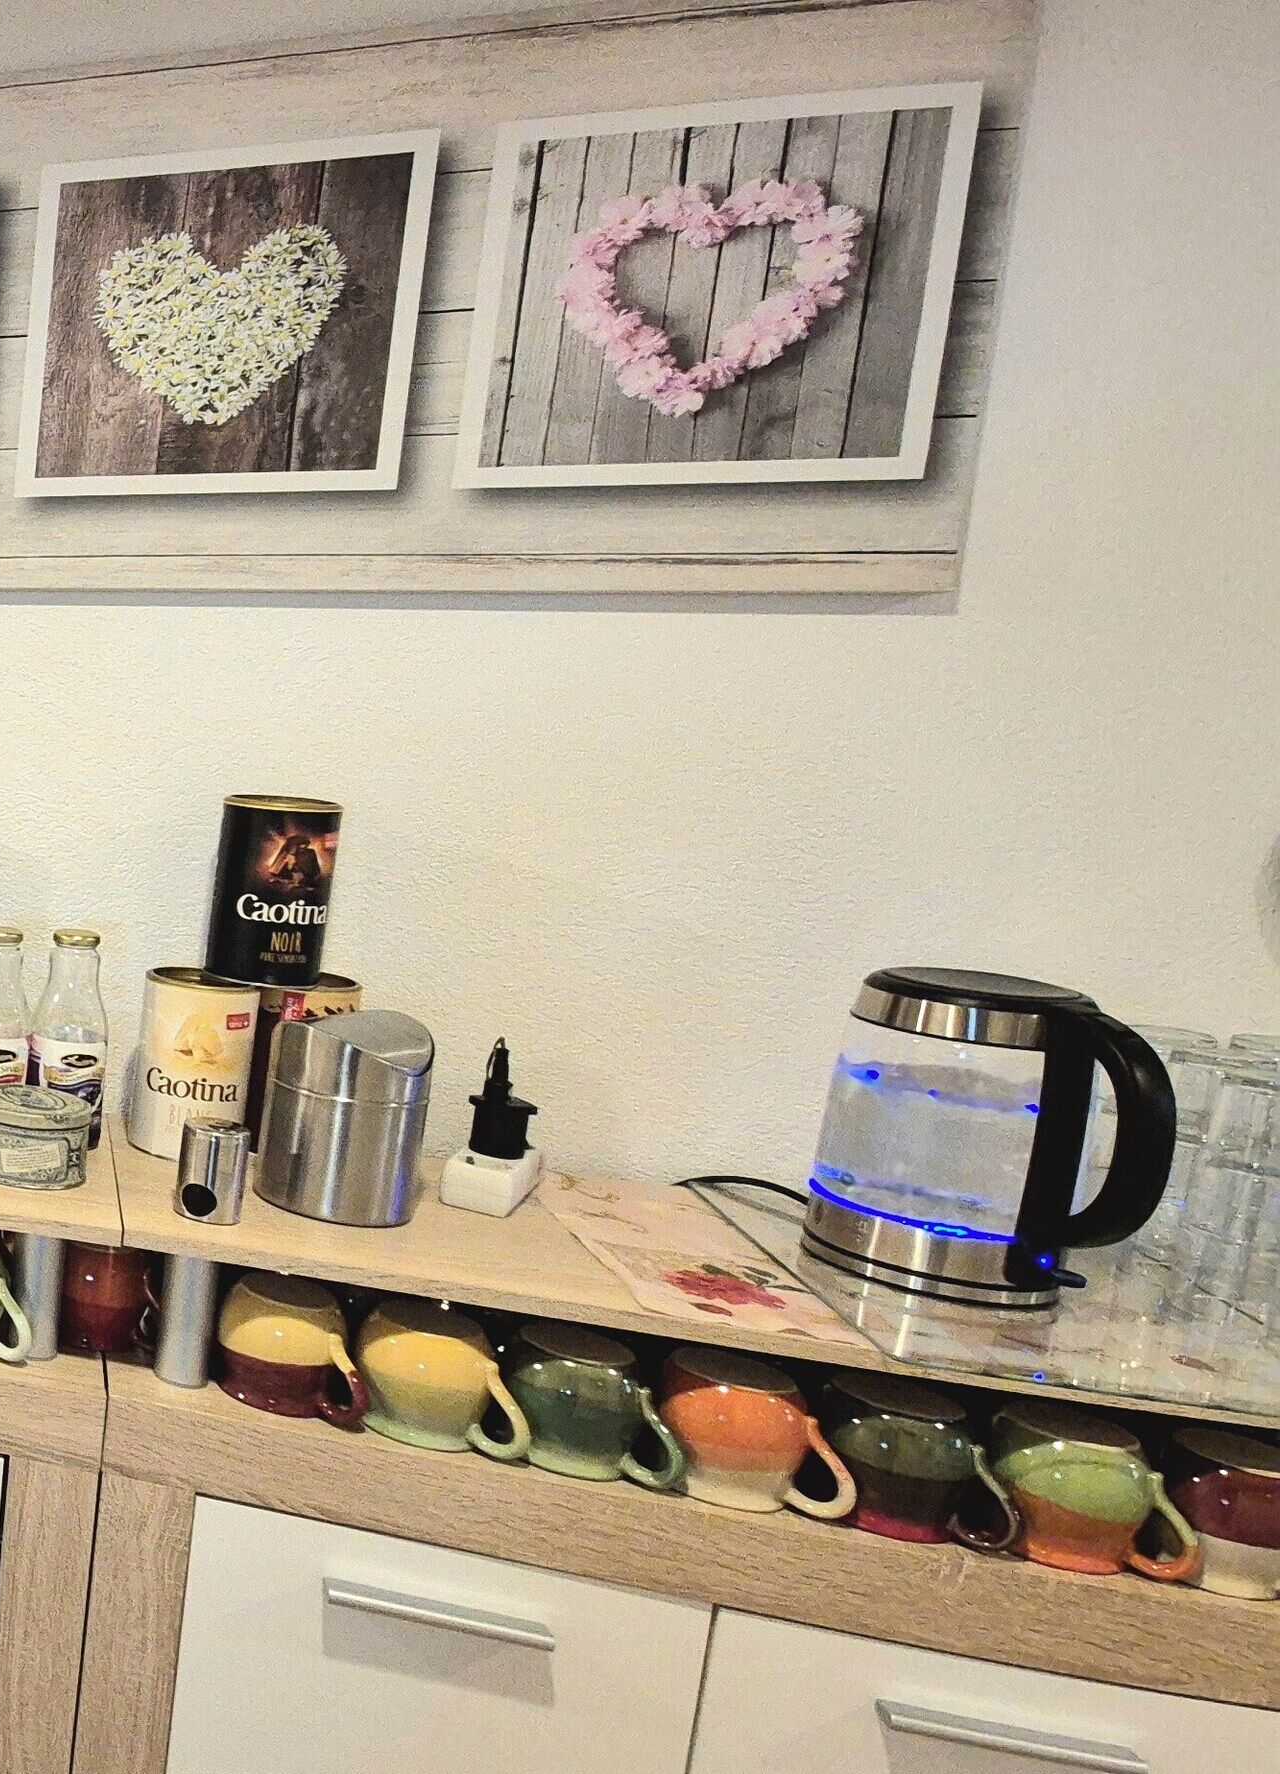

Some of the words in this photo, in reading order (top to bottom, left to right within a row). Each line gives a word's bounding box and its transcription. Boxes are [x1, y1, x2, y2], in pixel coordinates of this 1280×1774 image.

[236, 893, 328, 925] Caotina
[270, 931, 302, 953] NOIR
[146, 1067, 238, 1102] Caotina
